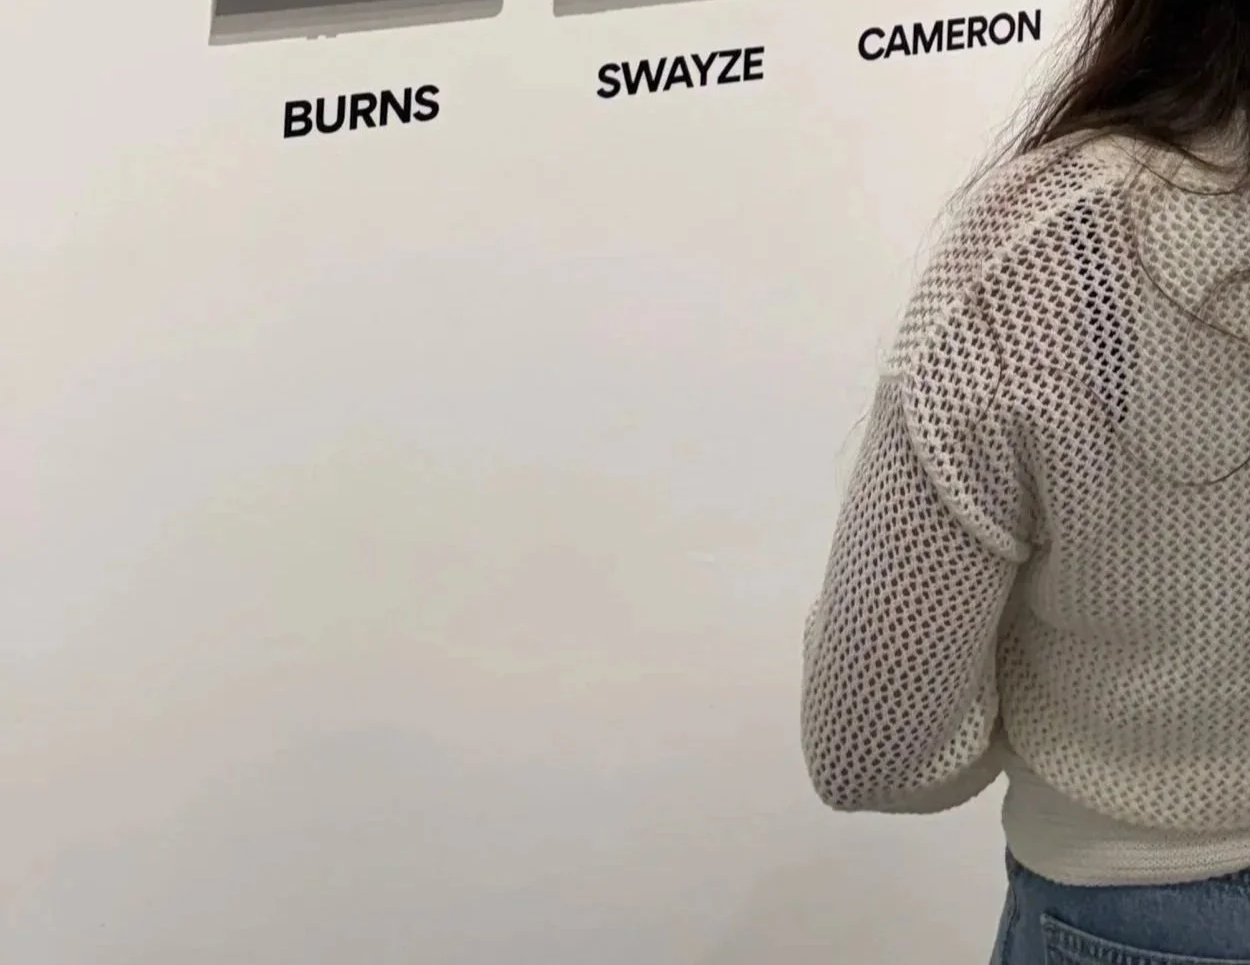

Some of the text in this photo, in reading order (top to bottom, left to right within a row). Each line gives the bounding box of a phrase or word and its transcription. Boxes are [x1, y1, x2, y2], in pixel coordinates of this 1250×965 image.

[857, 9, 1041, 61] CAMERON
[596, 46, 765, 99] SWAYZE
[283, 84, 440, 139] BURNS
